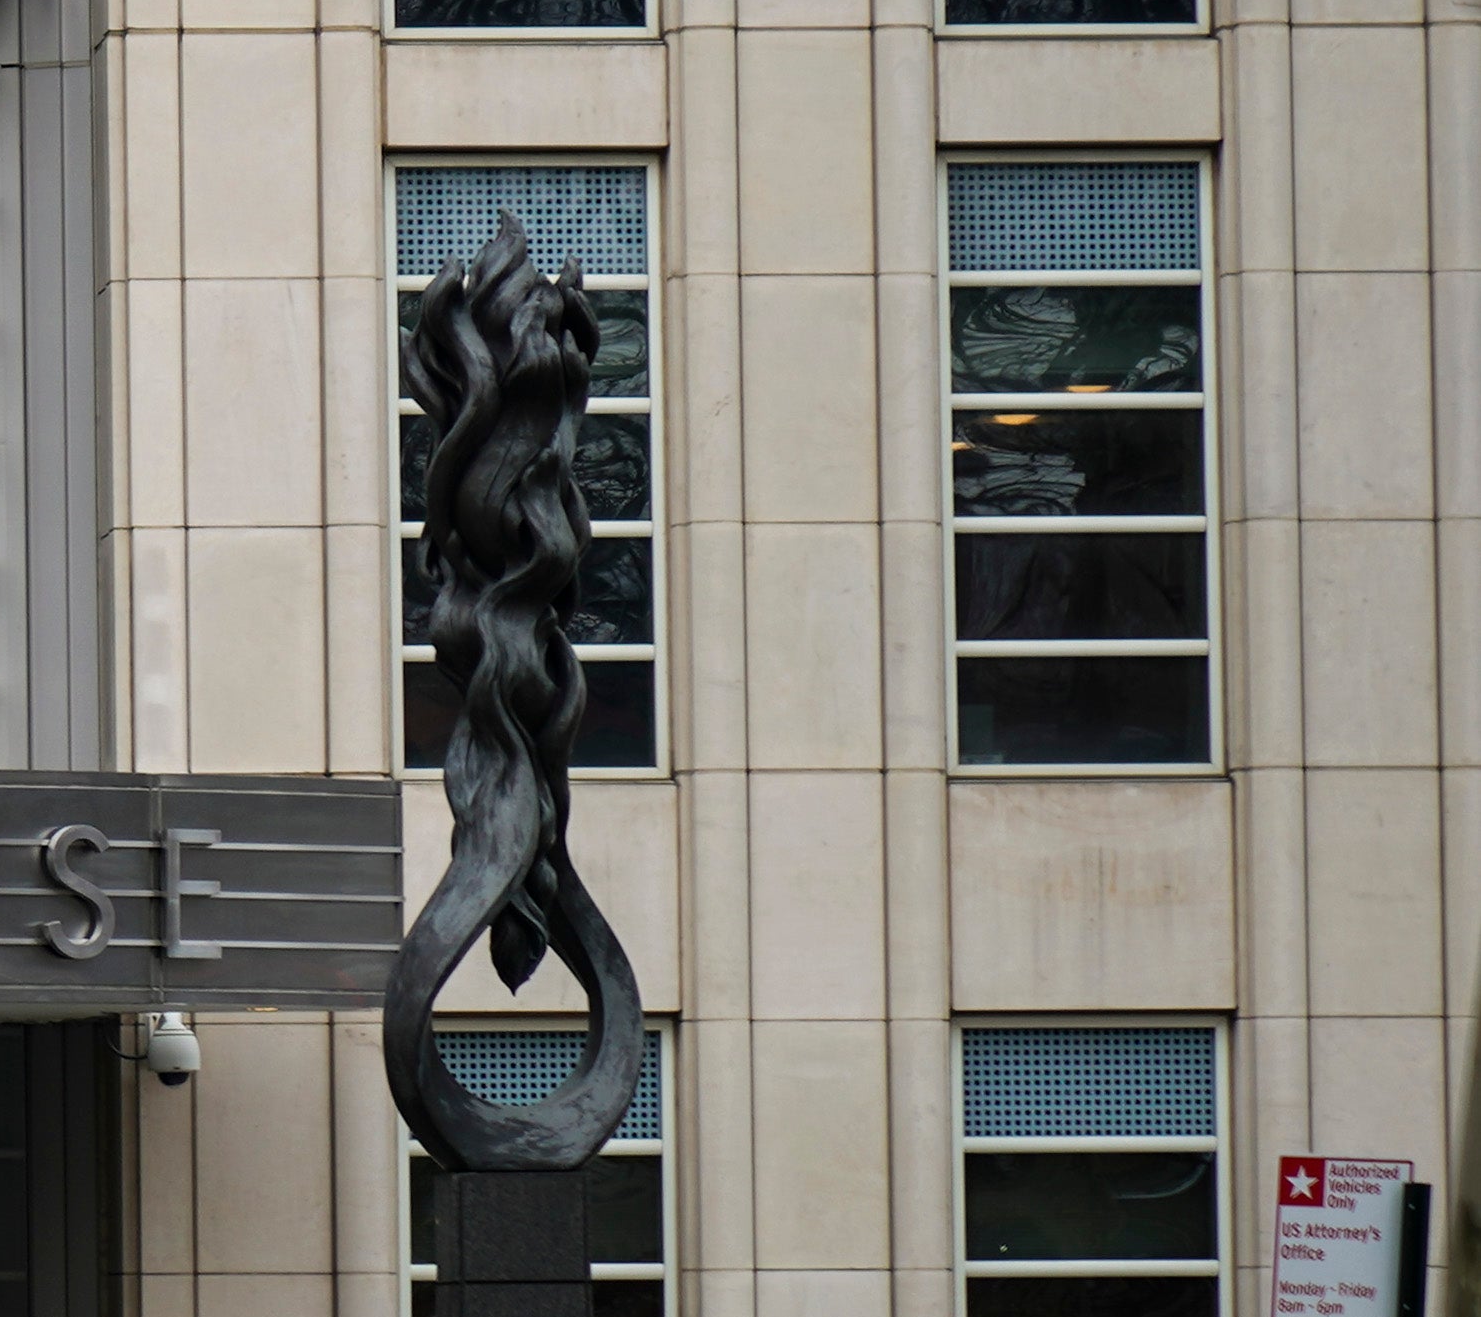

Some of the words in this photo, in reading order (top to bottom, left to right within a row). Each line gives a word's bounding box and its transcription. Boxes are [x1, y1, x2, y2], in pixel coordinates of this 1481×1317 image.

[1328, 1163, 1400, 1180] Authorized
[1328, 1178, 1382, 1195] Vehicles
[1327, 1194, 1355, 1213] Only
[1282, 1222, 1301, 1239] US
[1305, 1224, 1383, 1244] Attorney's
[1280, 1244, 1325, 1261] Office
[1279, 1281, 1326, 1298] Monday
[1338, 1282, 1377, 1301] Friday
